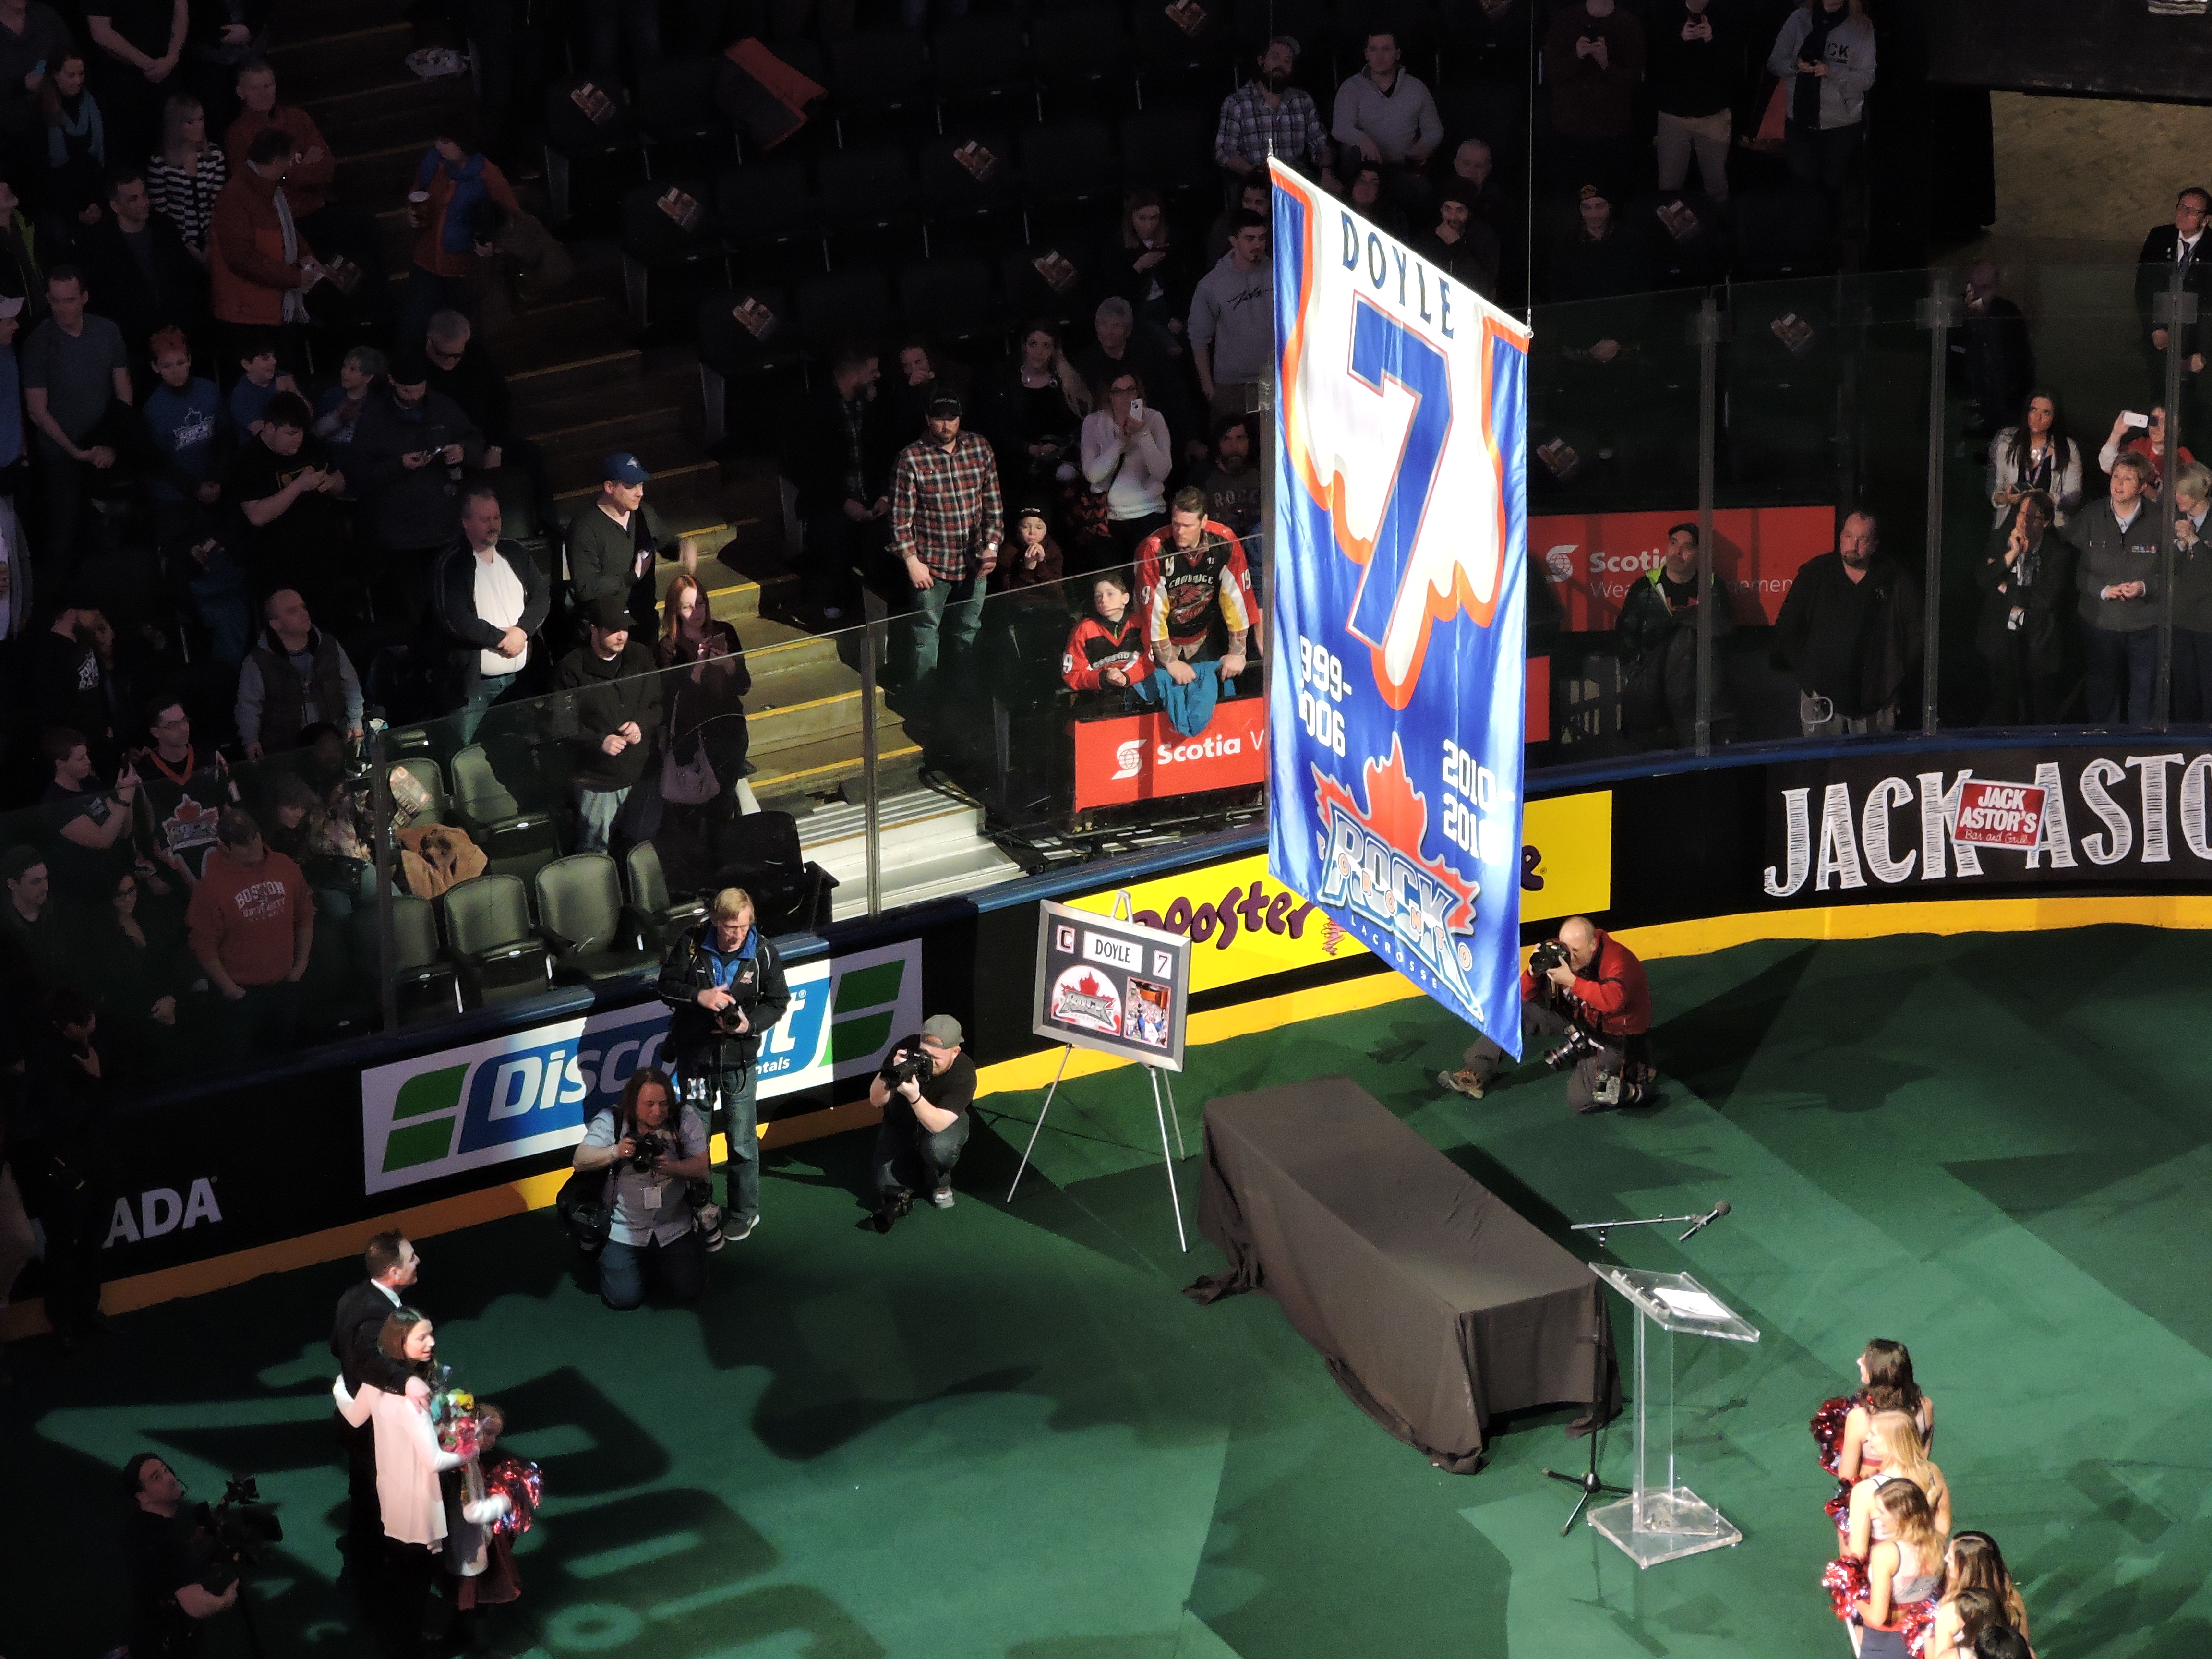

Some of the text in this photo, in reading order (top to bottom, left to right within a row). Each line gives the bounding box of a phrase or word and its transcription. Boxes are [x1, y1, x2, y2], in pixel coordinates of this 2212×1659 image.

[1340, 210, 1455, 339] DOYLE
[1346, 290, 1453, 649] 7
[1589, 548, 1667, 573] Scoti
[1157, 733, 1241, 765] Scotia
[1978, 787, 2027, 810] JACK
[1764, 769, 1984, 897] JACK
[1959, 807, 2037, 833] ASTOR'S
[1965, 829, 1983, 841] Bar
[1986, 832, 2003, 842] and
[1318, 804, 1484, 1022] ROCK
[1094, 939, 1131, 964] DOYLE
[1156, 954, 1168, 974] 7
[1350, 915, 1437, 989] LACROSSE
